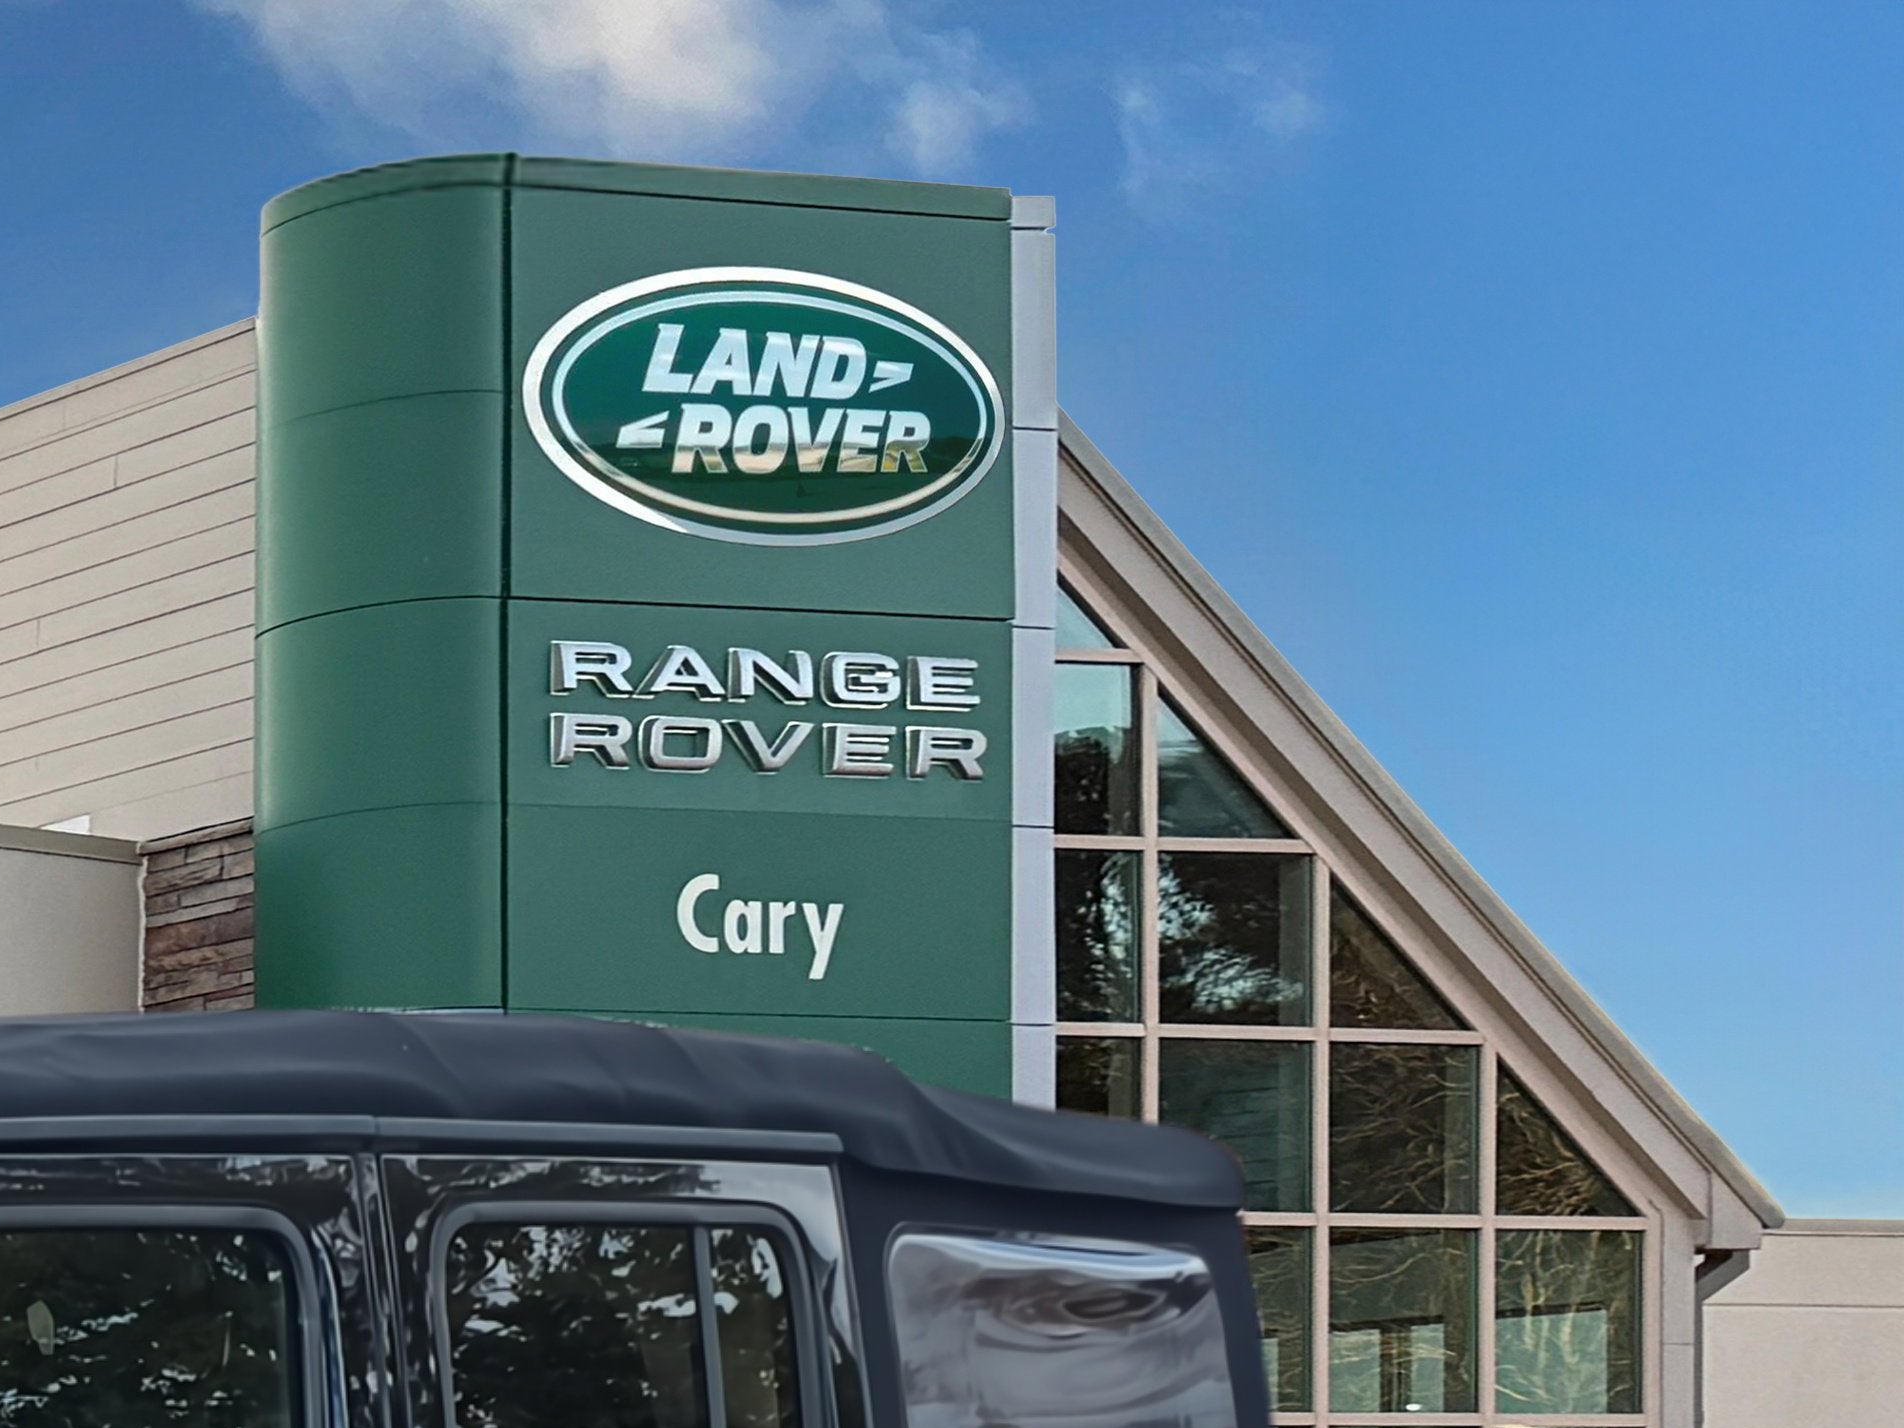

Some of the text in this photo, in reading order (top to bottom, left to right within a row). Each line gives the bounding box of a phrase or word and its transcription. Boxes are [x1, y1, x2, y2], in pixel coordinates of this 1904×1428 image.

[641, 323, 867, 400] LAND
[671, 402, 932, 475] ROVER
[549, 640, 981, 712] RANGE
[549, 712, 988, 781] ROVER
[676, 873, 844, 980] Cary
